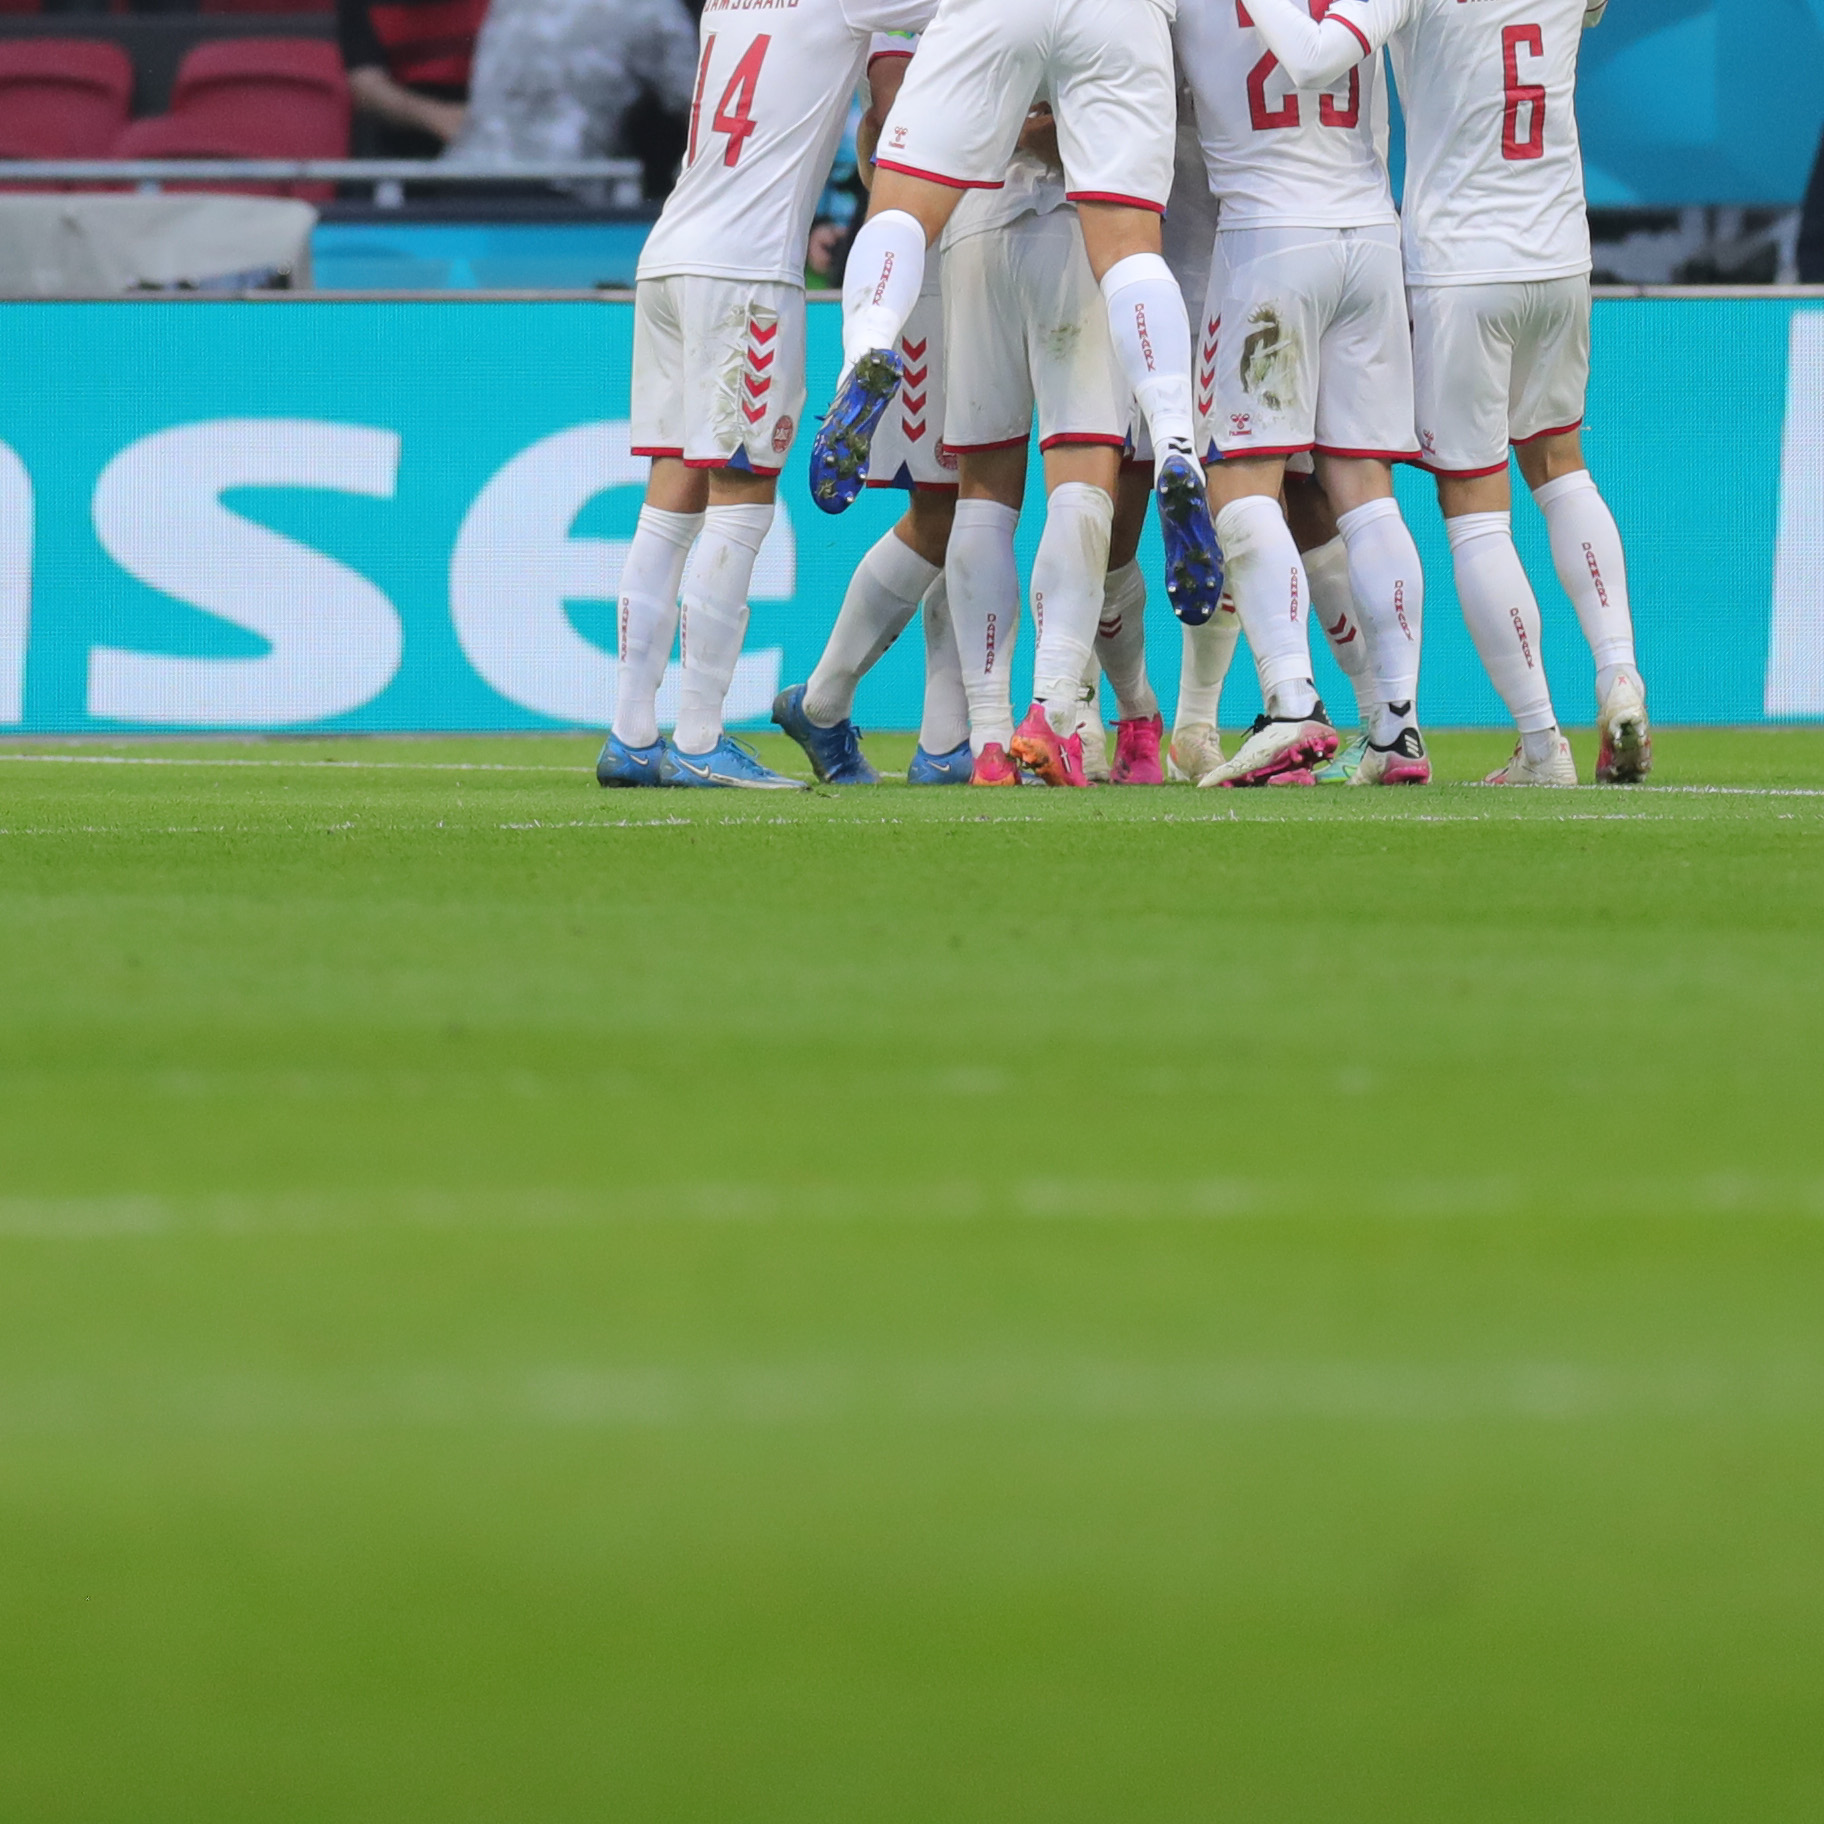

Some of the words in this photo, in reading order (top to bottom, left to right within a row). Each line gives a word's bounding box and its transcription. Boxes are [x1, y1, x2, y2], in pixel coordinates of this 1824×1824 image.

[686, 32, 773, 169] 14
[1501, 23, 1546, 161] 6
[872, 251, 895, 307] DANMARK
[1134, 302, 1157, 373] DANMARK
[1290, 566, 1299, 623] DANMARK
[1580, 541, 1610, 608] DANMARK
[1394, 579, 1414, 642] DANMARK
[1509, 607, 1535, 670] DANMARK
[983, 612, 997, 675] DANMARK
